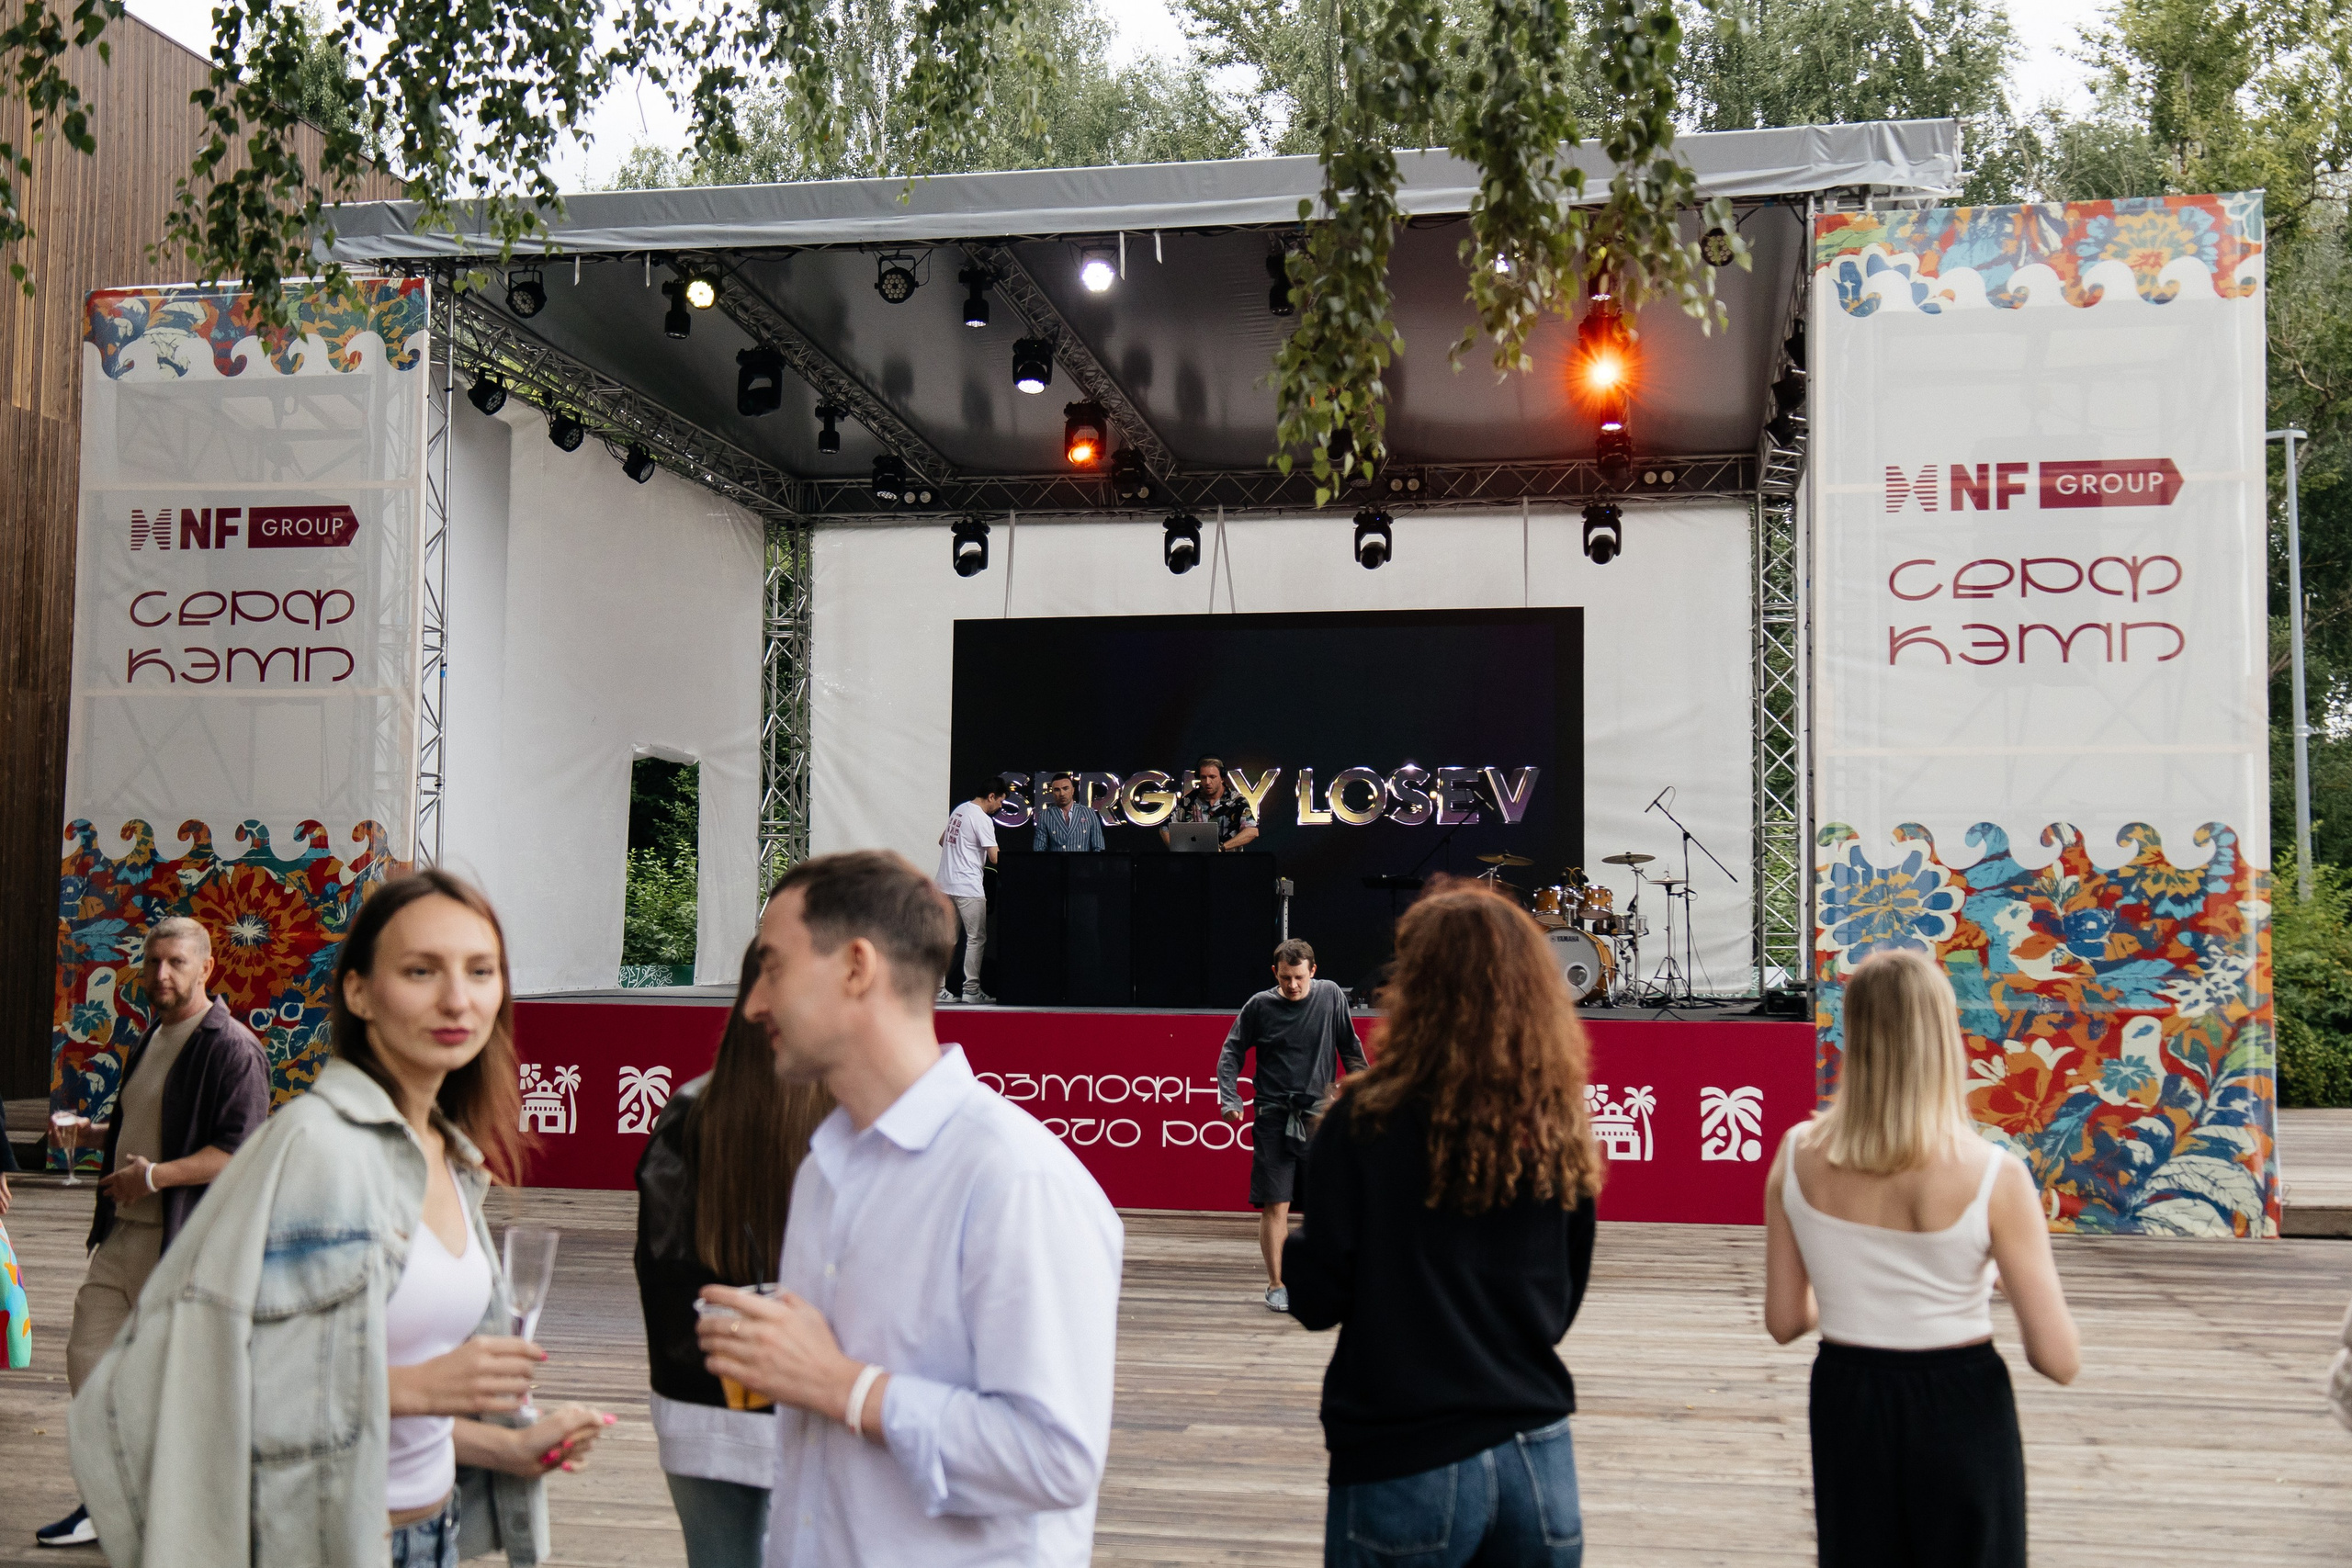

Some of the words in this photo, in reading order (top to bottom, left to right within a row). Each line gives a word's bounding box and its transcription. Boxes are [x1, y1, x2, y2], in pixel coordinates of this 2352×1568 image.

[1950, 461, 2030, 512] NF
[2054, 471, 2164, 495] GROUP
[180, 508, 242, 549] NF
[261, 517, 344, 536] GROUP
[1295, 766, 1540, 826] LOSEV
